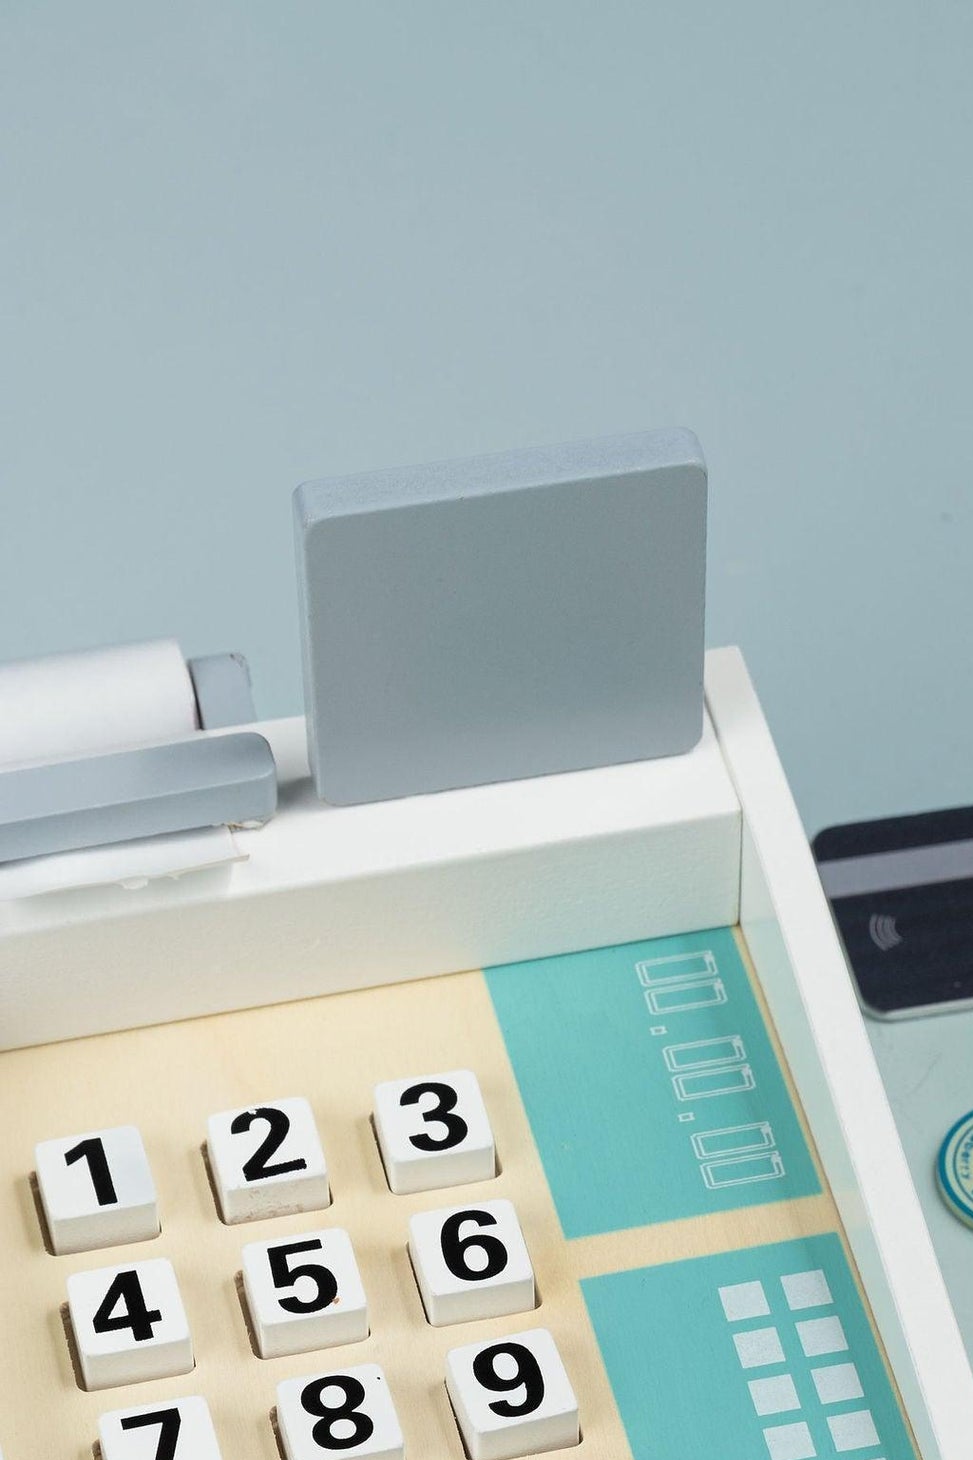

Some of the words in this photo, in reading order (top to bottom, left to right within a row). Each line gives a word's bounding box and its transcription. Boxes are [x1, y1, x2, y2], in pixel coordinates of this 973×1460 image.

[65, 1138, 118, 1206] 1
[231, 1107, 307, 1182] 2
[400, 1082, 468, 1152] 3
[92, 1270, 163, 1342] 4
[266, 1238, 338, 1314] 5
[440, 1209, 508, 1282] 6
[300, 1375, 374, 1451] 8
[472, 1342, 545, 1418] 9
